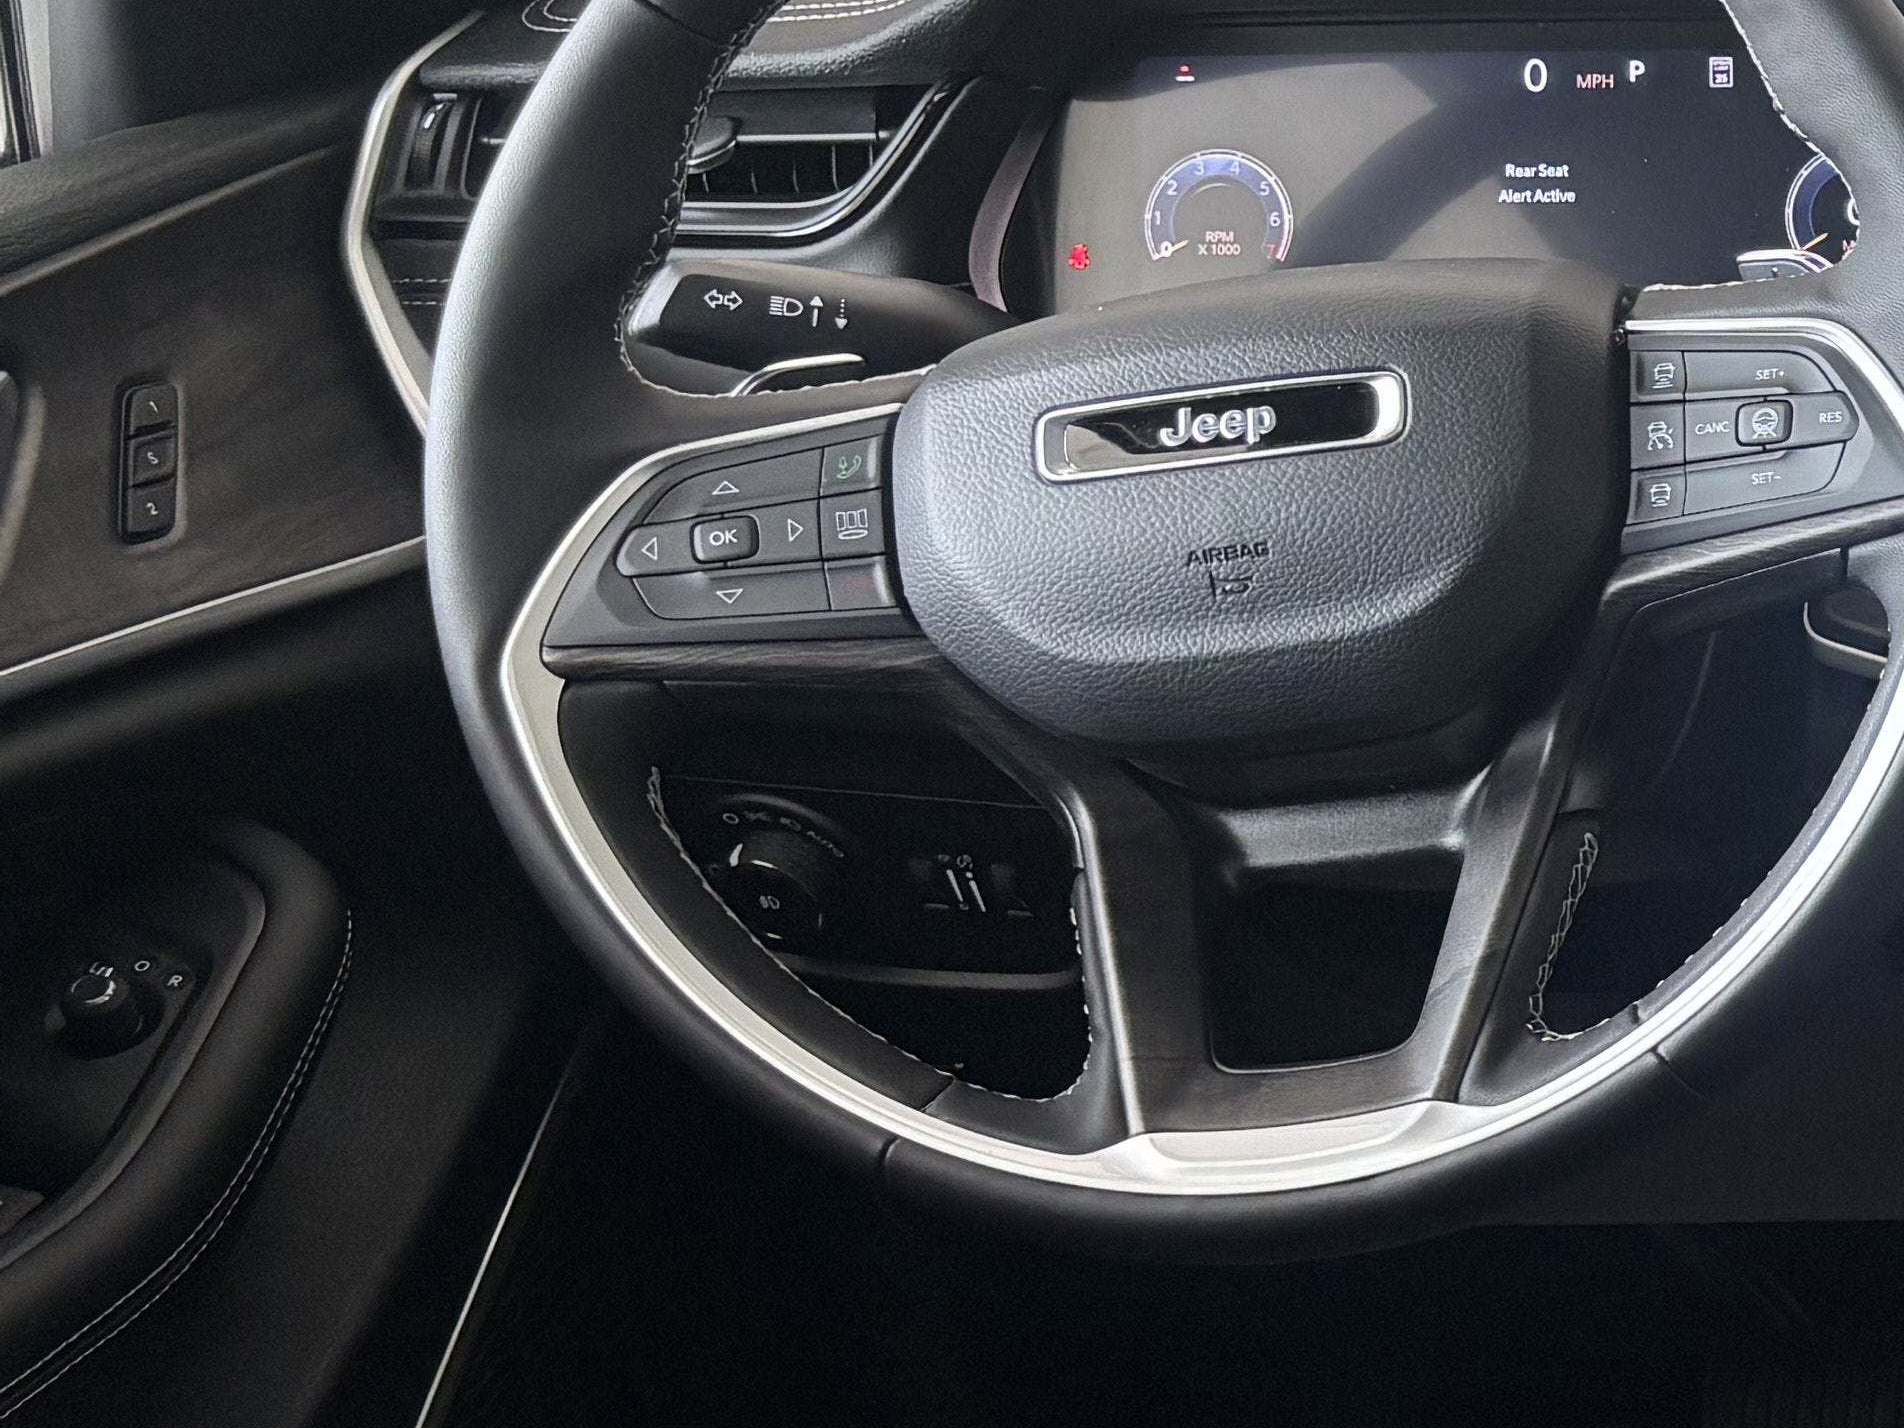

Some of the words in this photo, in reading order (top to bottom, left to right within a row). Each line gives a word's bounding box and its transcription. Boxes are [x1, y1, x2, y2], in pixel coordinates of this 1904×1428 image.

[1628, 60, 1645, 82] P
[1576, 74, 1614, 89] MPH
[1195, 162, 1204, 176] 3
[1230, 161, 1240, 175] 4
[1505, 164, 1536, 178] Rear
[1538, 163, 1569, 178] Seat
[1167, 182, 1178, 196] 2
[1260, 182, 1270, 196] 5
[1498, 190, 1532, 202] Alert
[1533, 189, 1576, 203] Active
[1154, 211, 1161, 225] 1
[1270, 212, 1280, 226] 6
[1206, 231, 1234, 242] RPM
[1198, 244, 1209, 254] X
[1212, 244, 1240, 255] 1000
[1819, 412, 1842, 424] RES
[1160, 405, 1277, 447] Jeep
[1695, 421, 1730, 435] CANC
[147, 452, 159, 464] S
[146, 502, 159, 515] 2
[708, 529, 738, 548] OK
[1186, 540, 1270, 566] AIRBAG
[167, 975, 183, 987] R
